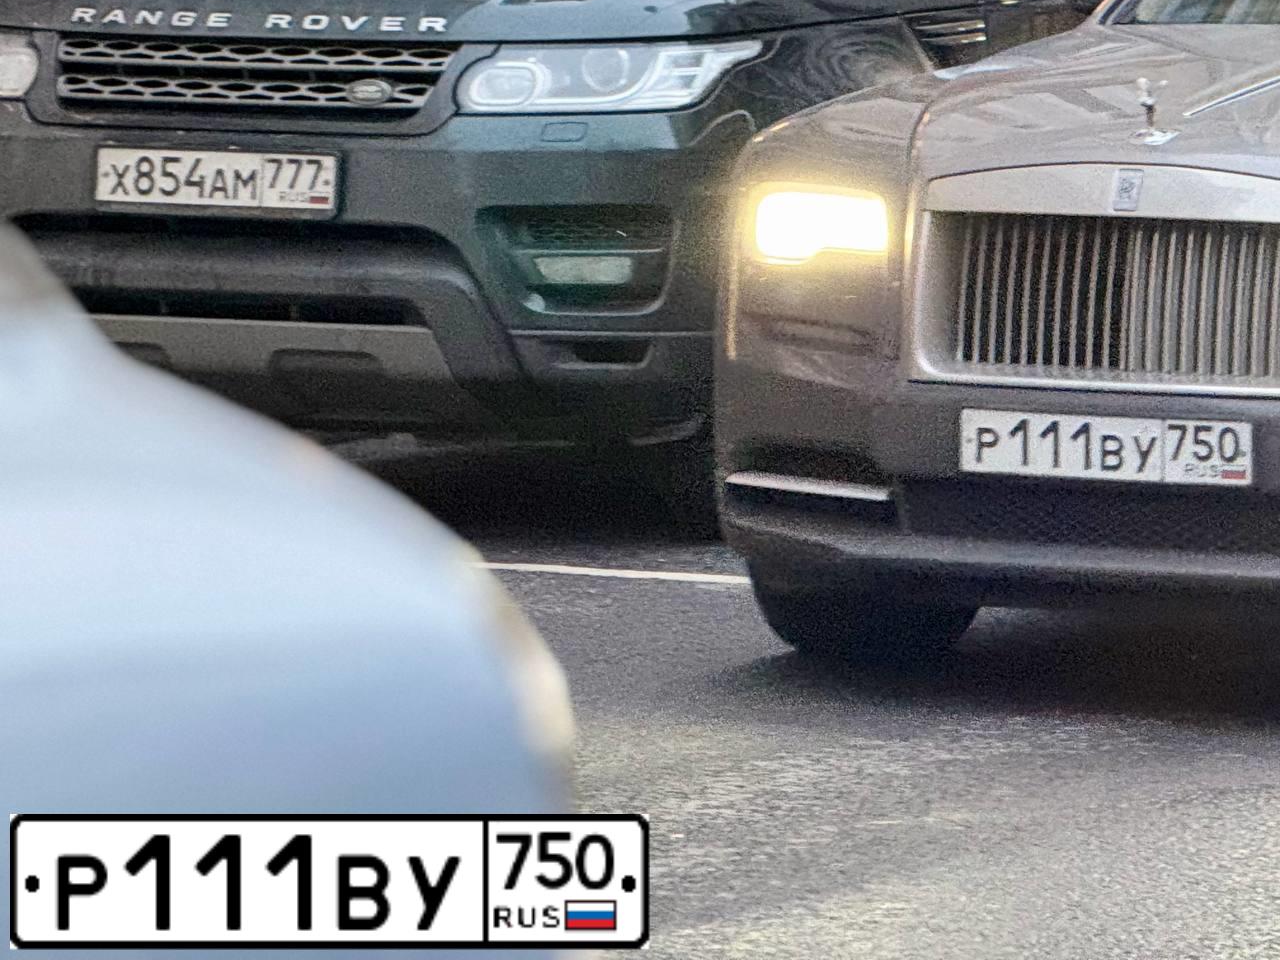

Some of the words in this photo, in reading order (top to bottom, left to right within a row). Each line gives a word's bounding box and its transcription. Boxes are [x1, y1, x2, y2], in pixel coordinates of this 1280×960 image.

[70, 7, 232, 28] RANGE
[264, 13, 448, 33] ROVER
[264, 158, 323, 190] 777
[1167, 423, 1241, 463] 750
